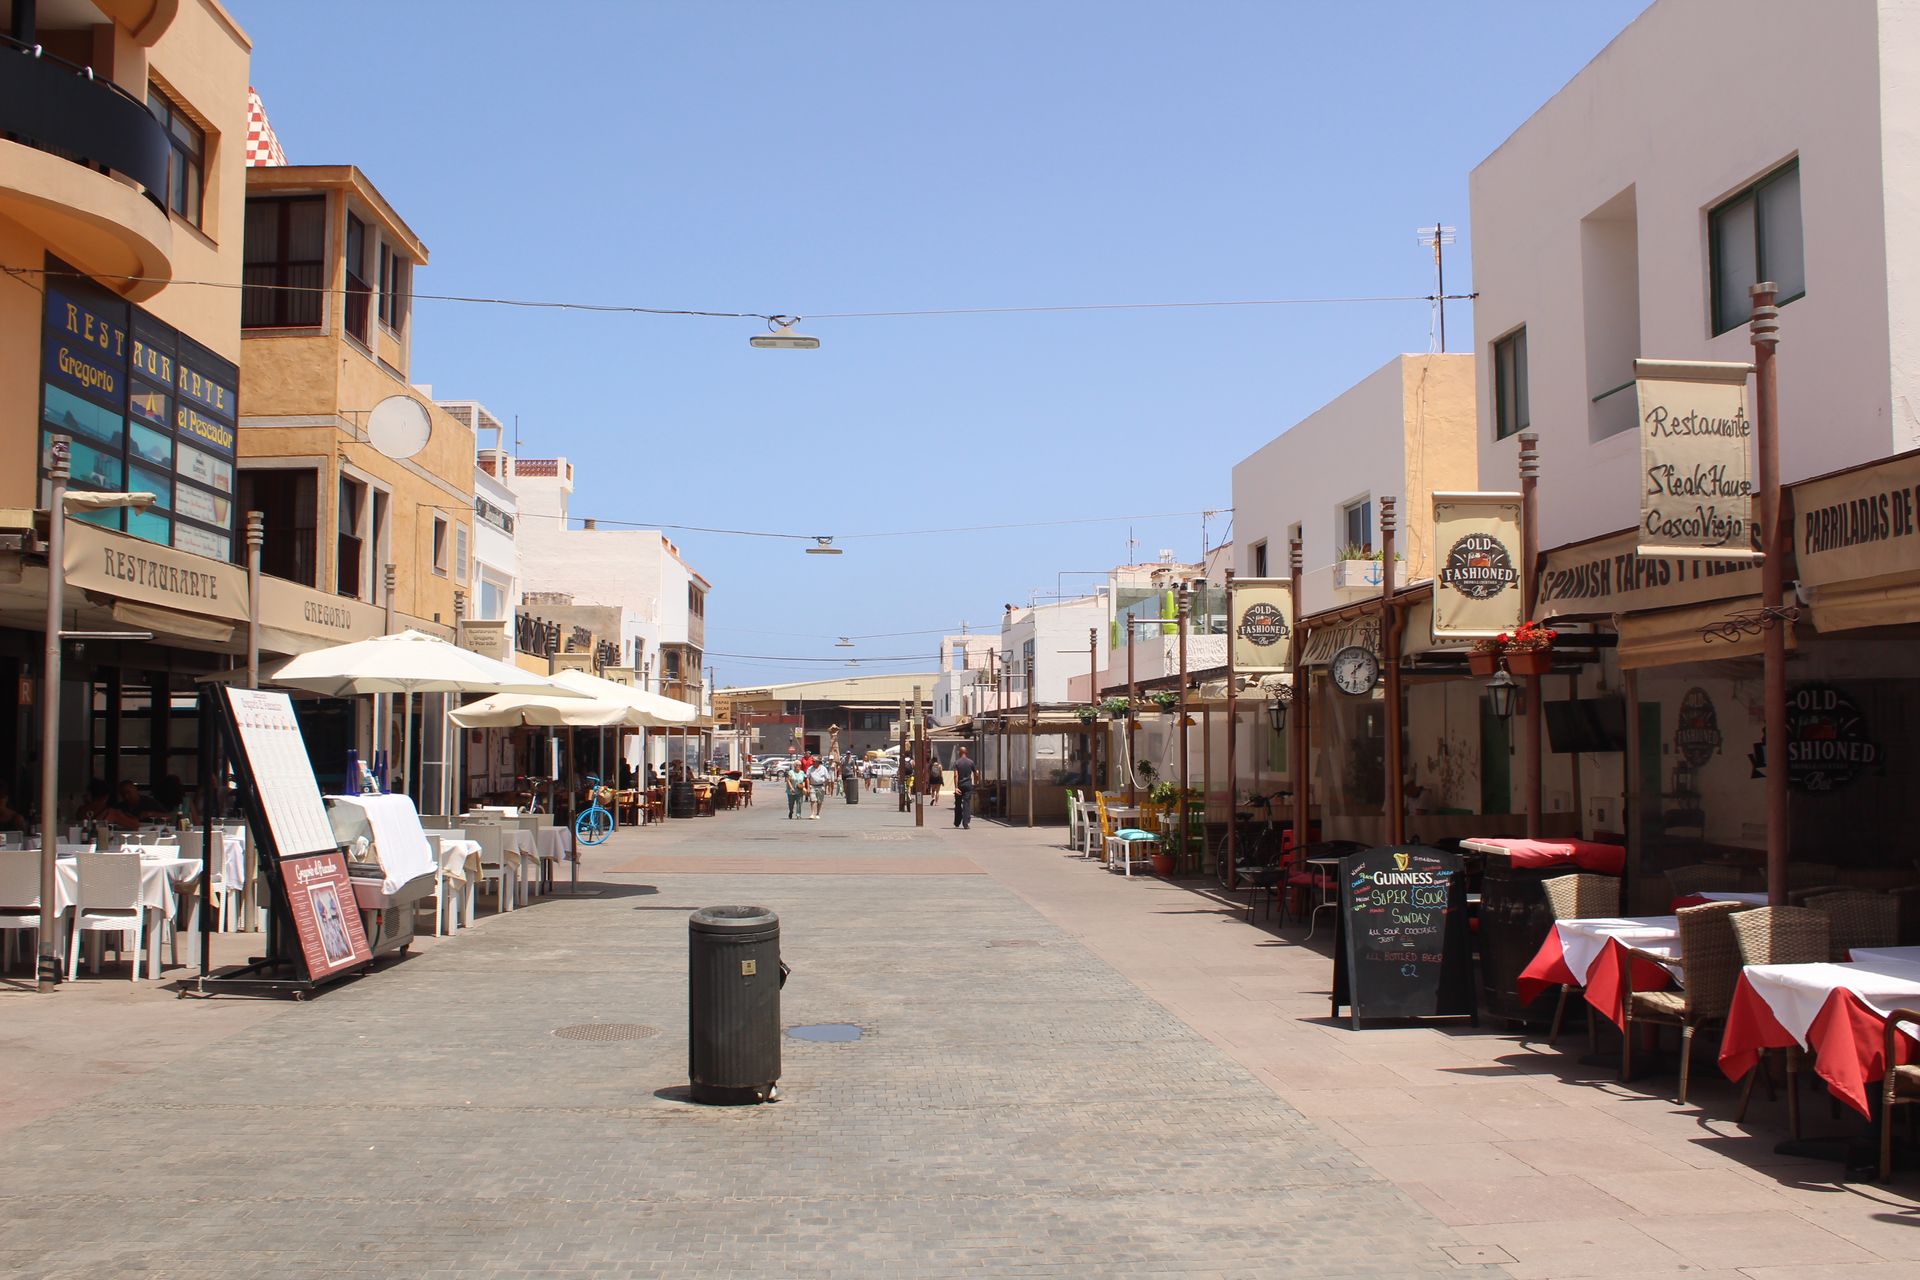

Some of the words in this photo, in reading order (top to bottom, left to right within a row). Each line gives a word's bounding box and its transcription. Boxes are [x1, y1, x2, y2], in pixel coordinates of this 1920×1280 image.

[66, 302, 224, 410] RESTAURANTE
[59, 347, 114, 393] Gregorio
[178, 410, 187, 426] el
[189, 410, 232, 449] Pescador
[1645, 405, 1751, 437] Restaurante
[1645, 509, 1700, 539] Casco
[1695, 505, 1743, 547] Viejo
[1806, 492, 1889, 555] PARRILADAS
[1892, 488, 1912, 538] DE
[1466, 538, 1491, 550] OLD
[104, 547, 218, 600] RESTAURANTE
[1445, 567, 1513, 581] FASHIONED
[1540, 558, 1611, 605] SPANISH
[1615, 552, 1671, 593] TAPAS
[304, 603, 351, 630] GREGORIO
[1254, 606, 1272, 614] OLD
[1241, 625, 1286, 635] FASHIONED
[22, 682, 31, 701] R
[1797, 690, 1837, 710] OLD
[1787, 740, 1876, 762] SHIONED
[1373, 871, 1433, 886] GUINNESS
[1415, 888, 1445, 905] SOUR
[1391, 908, 1430, 926] SUNDAY
